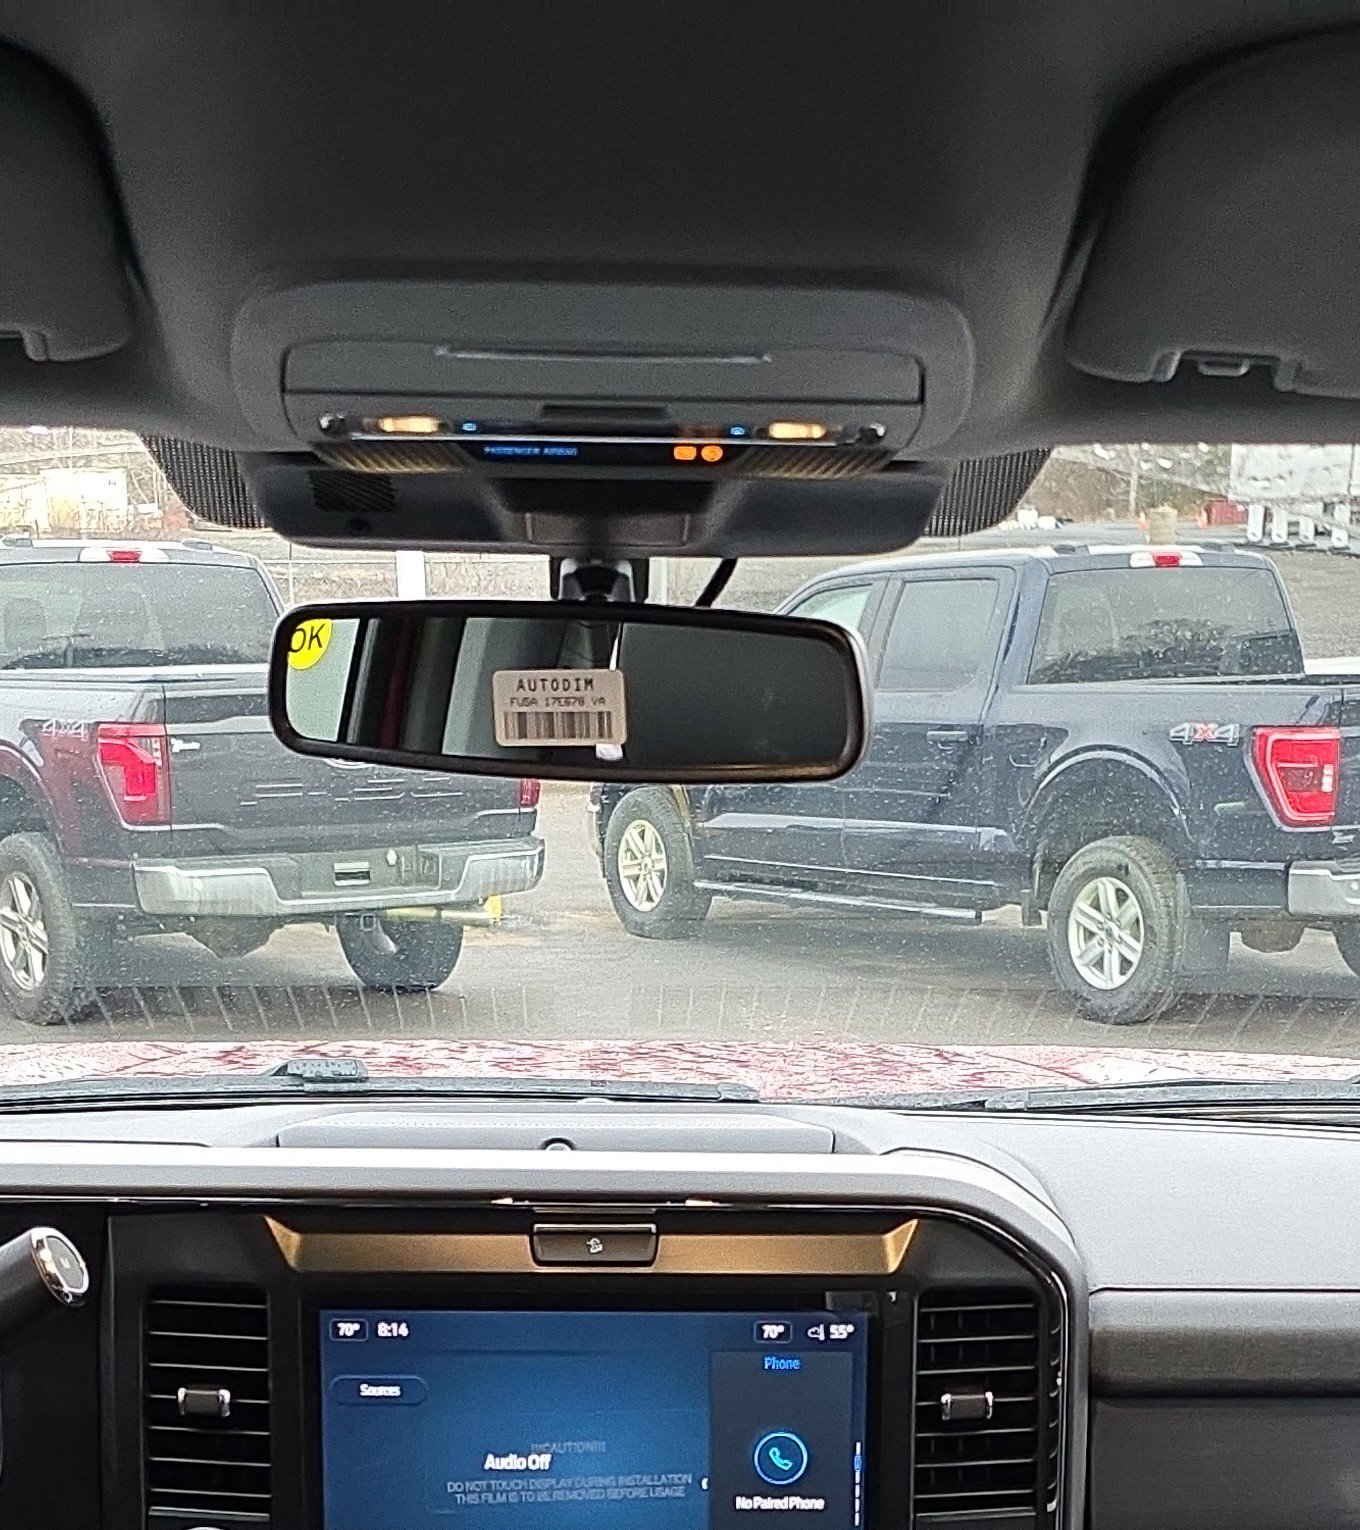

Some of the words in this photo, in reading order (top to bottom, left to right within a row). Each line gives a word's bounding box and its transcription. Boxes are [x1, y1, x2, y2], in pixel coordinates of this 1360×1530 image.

[290, 623, 325, 653] OK
[517, 677, 594, 692] AUTODIM
[337, 1322, 360, 1337] 70°
[377, 1322, 409, 1337] 8:14
[762, 1324, 785, 1339] 70°
[829, 1324, 855, 1339] 55°
[764, 1356, 801, 1370] Phone
[360, 1383, 401, 1396] Sources
[484, 1453, 526, 1470] Audio
[528, 1453, 552, 1470] Off
[447, 1482, 463, 1493] DO
[465, 1481, 487, 1492] NOT
[489, 1480, 527, 1491] TOUCH
[529, 1478, 573, 1490] DISPLAY
[575, 1477, 616, 1488] DURING
[618, 1474, 692, 1486] INSTALLATION
[456, 1493, 478, 1504] THIS
[481, 1492, 506, 1503] FILM
[508, 1492, 518, 1502] IS
[520, 1491, 534, 1502] TO
[537, 1490, 550, 1501] BE
[553, 1488, 605, 1500] REMOVED
[607, 1487, 649, 1499] BEFORE
[651, 1486, 685, 1498] USAGE
[735, 1496, 752, 1510] No
[753, 1496, 789, 1510] Paired
[790, 1496, 825, 1510] Phone
